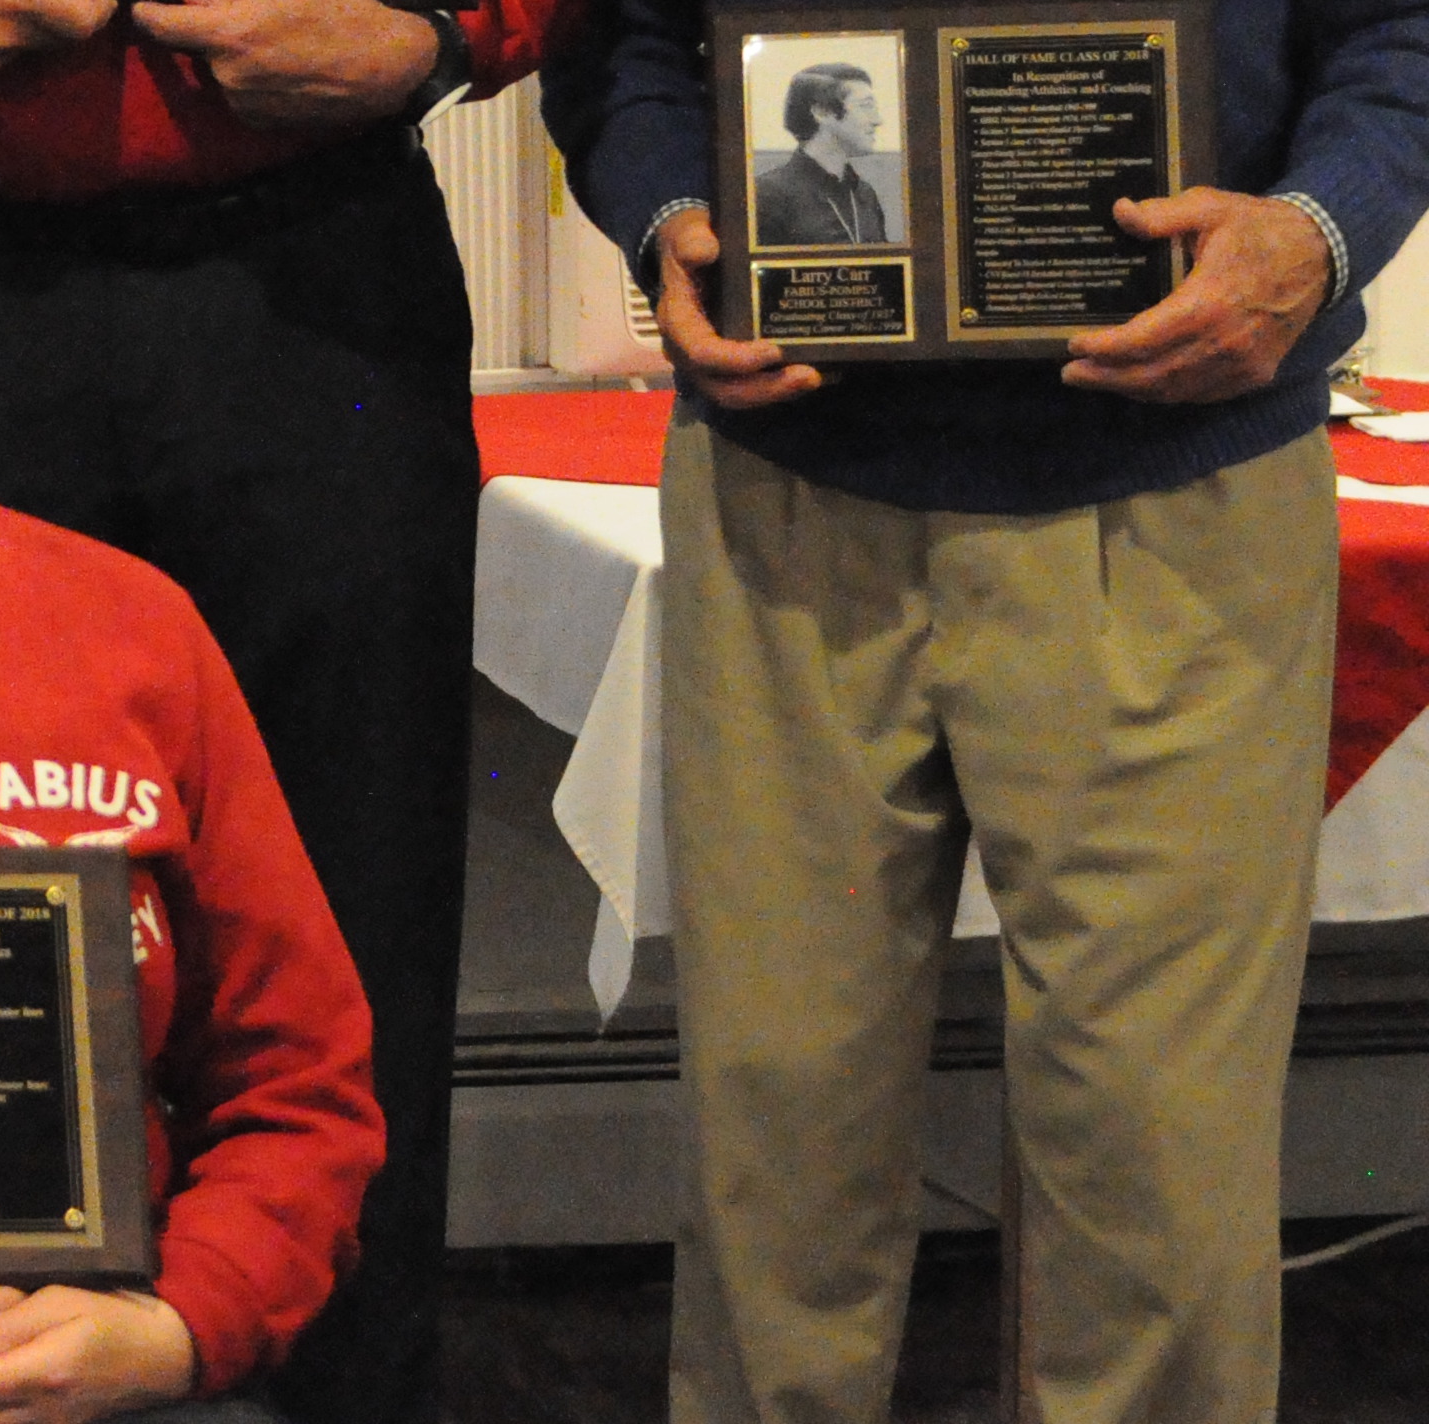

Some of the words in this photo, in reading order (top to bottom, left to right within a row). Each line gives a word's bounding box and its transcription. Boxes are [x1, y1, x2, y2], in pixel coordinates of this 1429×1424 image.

[966, 54, 1000, 65] HALL
[1002, 53, 1020, 64] OF
[1023, 52, 1057, 63] FAME
[1059, 51, 1100, 62] CLASS
[1102, 50, 1120, 61] OF
[1123, 50, 1149, 60] 2018
[1012, 72, 1024, 82] In
[1026, 70, 1089, 84] Recognition
[1091, 69, 1105, 80] of
[791, 268, 832, 285] Larry
[779, 299, 826, 309] SCHOOL
[19, 907, 50, 920] 2018
